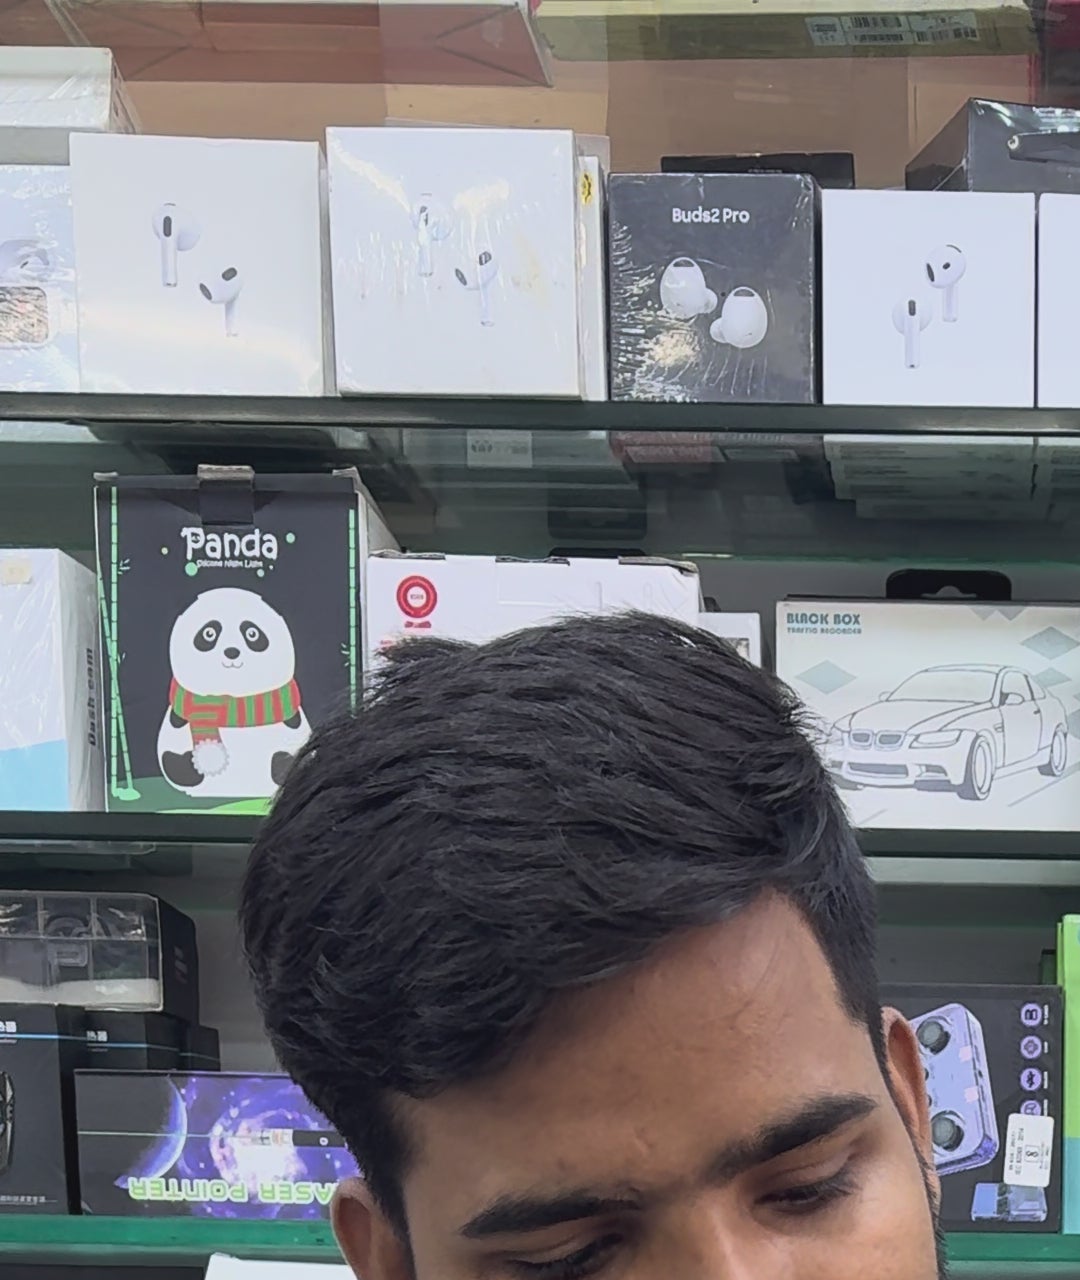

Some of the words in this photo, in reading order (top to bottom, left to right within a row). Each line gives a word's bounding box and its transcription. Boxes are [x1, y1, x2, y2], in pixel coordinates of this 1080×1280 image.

[671, 206, 720, 225] Buds2
[723, 206, 750, 226] Pro
[181, 527, 278, 560] Panda
[787, 613, 829, 624] BLACK
[833, 613, 861, 625] BOX
[128, 1176, 246, 1203] POINTER
[260, 1180, 334, 1205] ASER
